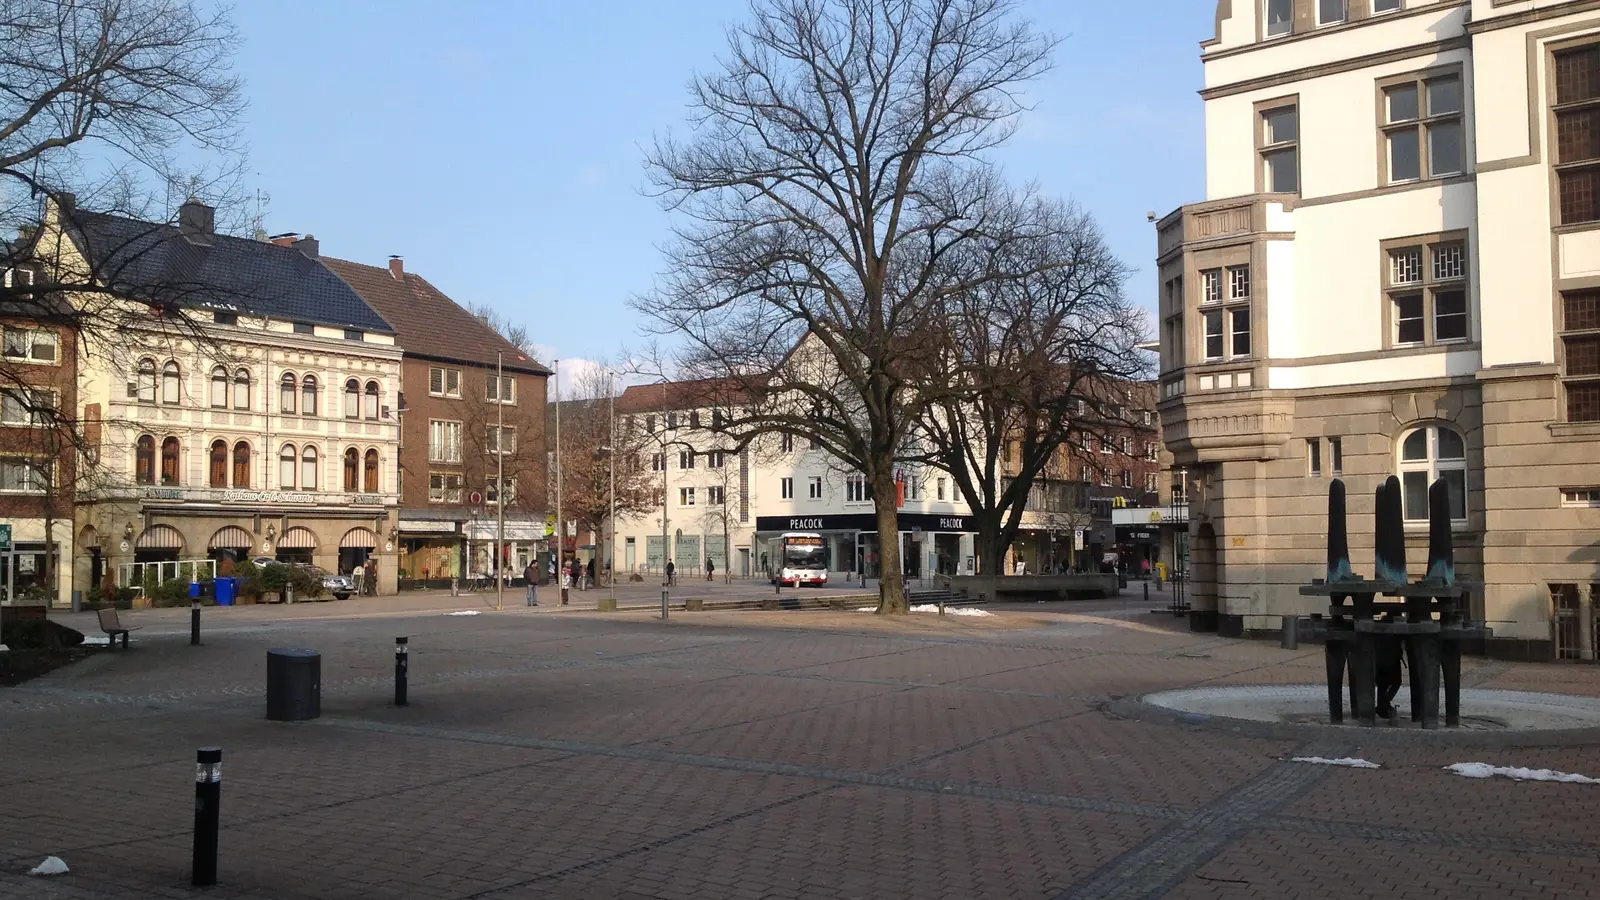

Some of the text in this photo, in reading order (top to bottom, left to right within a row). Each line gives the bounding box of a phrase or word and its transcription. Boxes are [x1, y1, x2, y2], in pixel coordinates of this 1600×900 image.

[223, 489, 257, 502] Rathaus
[790, 518, 823, 529] PEACOCK
[940, 518, 962, 528] PEACOCK
